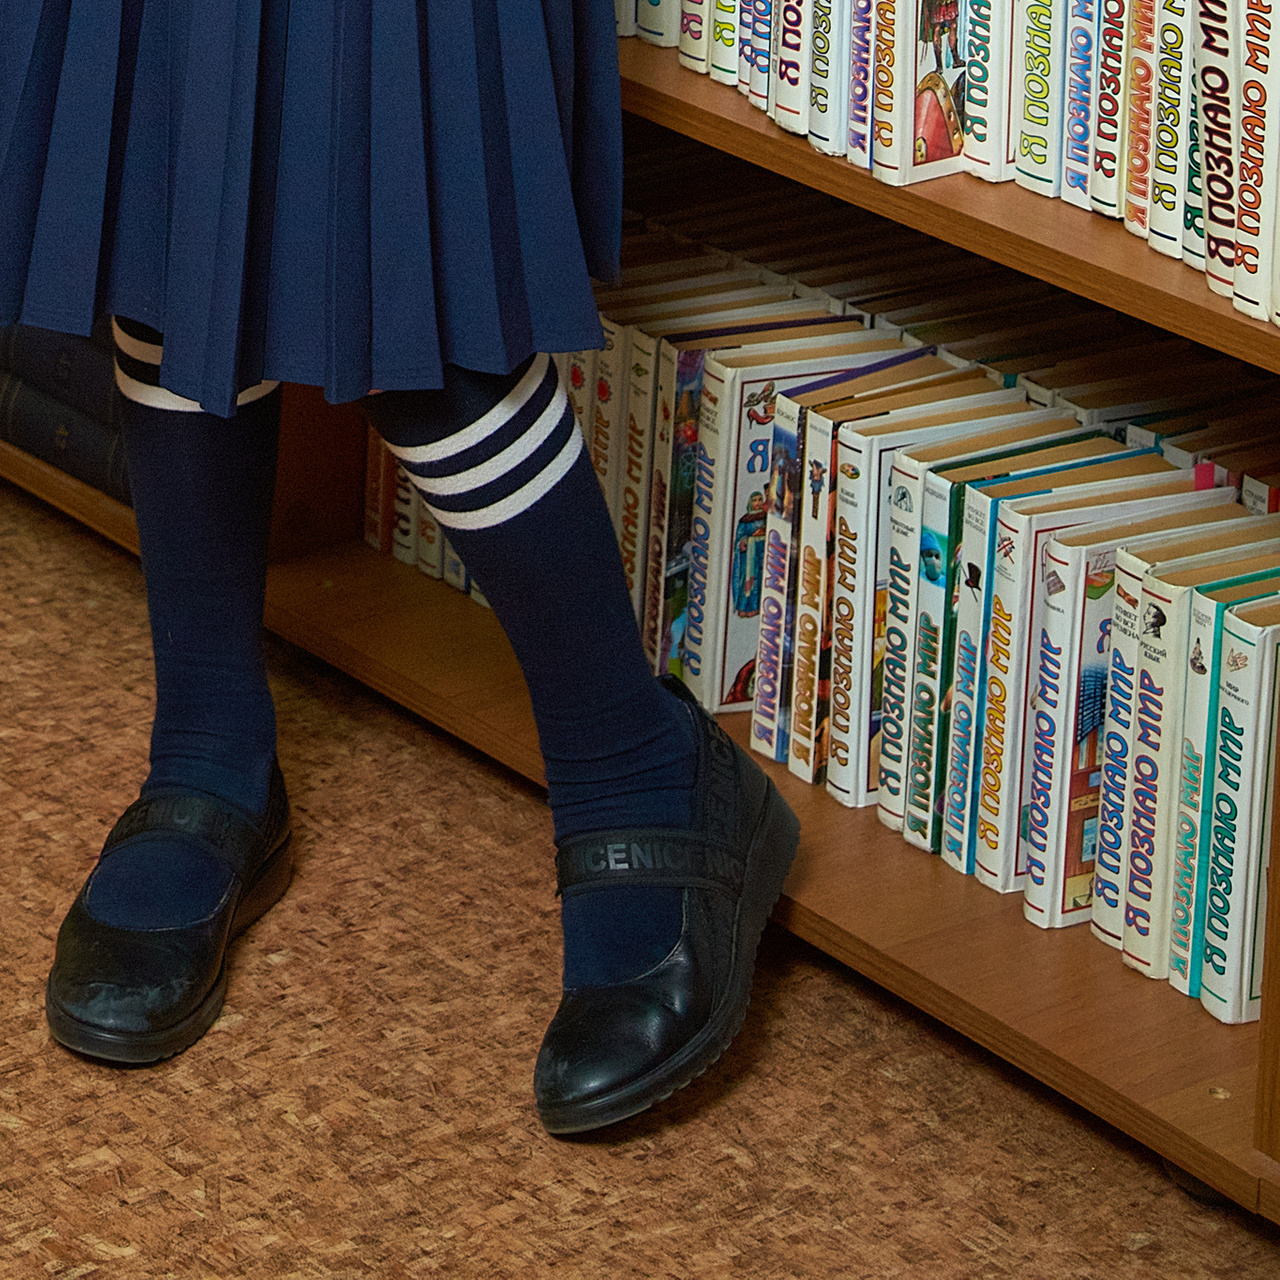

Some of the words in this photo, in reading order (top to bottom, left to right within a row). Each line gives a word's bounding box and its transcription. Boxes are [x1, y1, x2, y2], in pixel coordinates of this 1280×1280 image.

[964, 114, 987, 143] Я
[1019, 129, 1047, 165] Я
[1237, 81, 1268, 237] ПОЗНАЮ
[1233, 241, 1259, 275] Я
[838, 516, 857, 592] МИР
[831, 596, 855, 735] ПОЗНАЮ
[1138, 668, 1164, 751] МИР
[829, 739, 849, 767] Я
[1219, 706, 1245, 791] МИР
[1127, 754, 1159, 901] ПОЗНАЮ
[1206, 797, 1238, 937] ПОЗНАЮ
[1125, 904, 1150, 937] Я
[1203, 945, 1226, 976] Я
